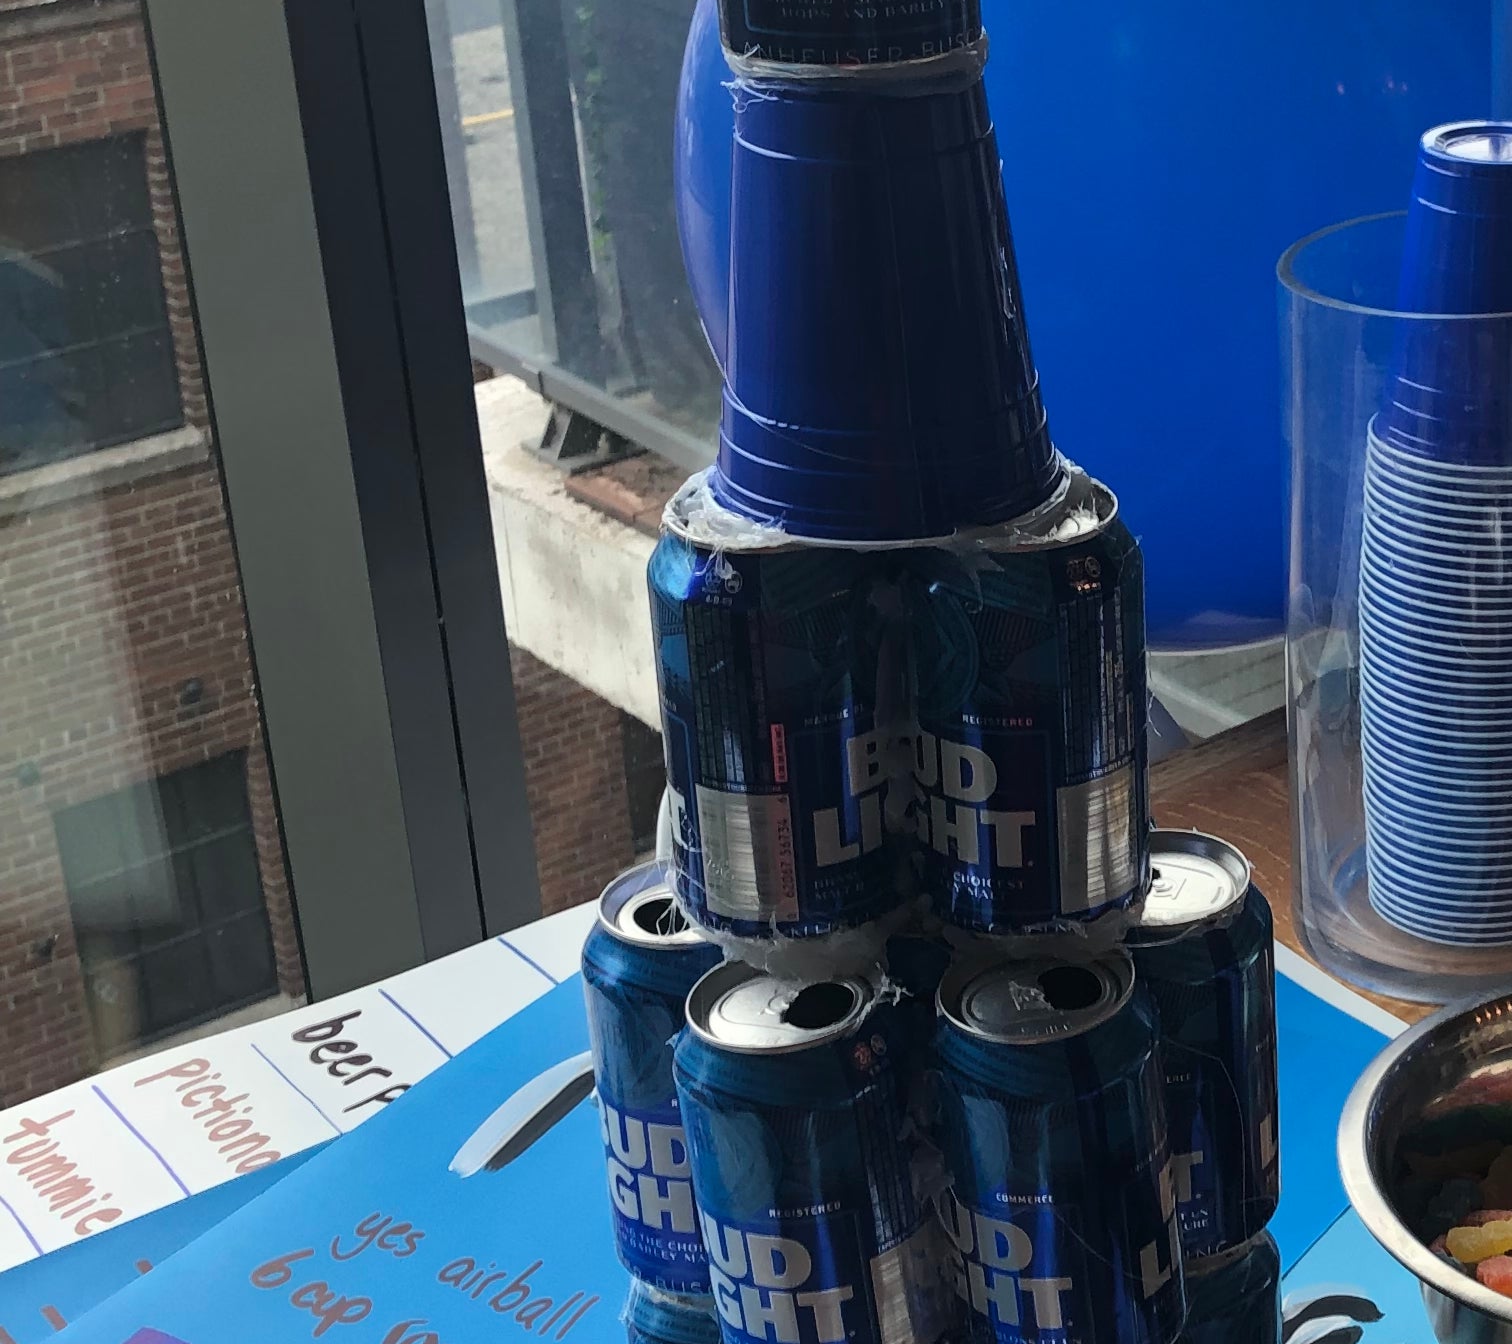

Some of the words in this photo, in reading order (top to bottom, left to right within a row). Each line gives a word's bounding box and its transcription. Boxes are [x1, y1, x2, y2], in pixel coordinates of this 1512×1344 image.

[291, 1009, 392, 1086] beer
[133, 1057, 281, 1174] pictiona
[601, 1104, 692, 1180] UD
[768, 1200, 841, 1218] REGISTERED
[995, 1192, 1054, 1204] COMMERCE
[330, 1211, 425, 1262] yes
[436, 1256, 600, 1341] airball
[703, 1210, 812, 1289] UD
[249, 1247, 315, 1290] 6
[290, 1280, 373, 1339] cup
[709, 1263, 854, 1344] GHT
